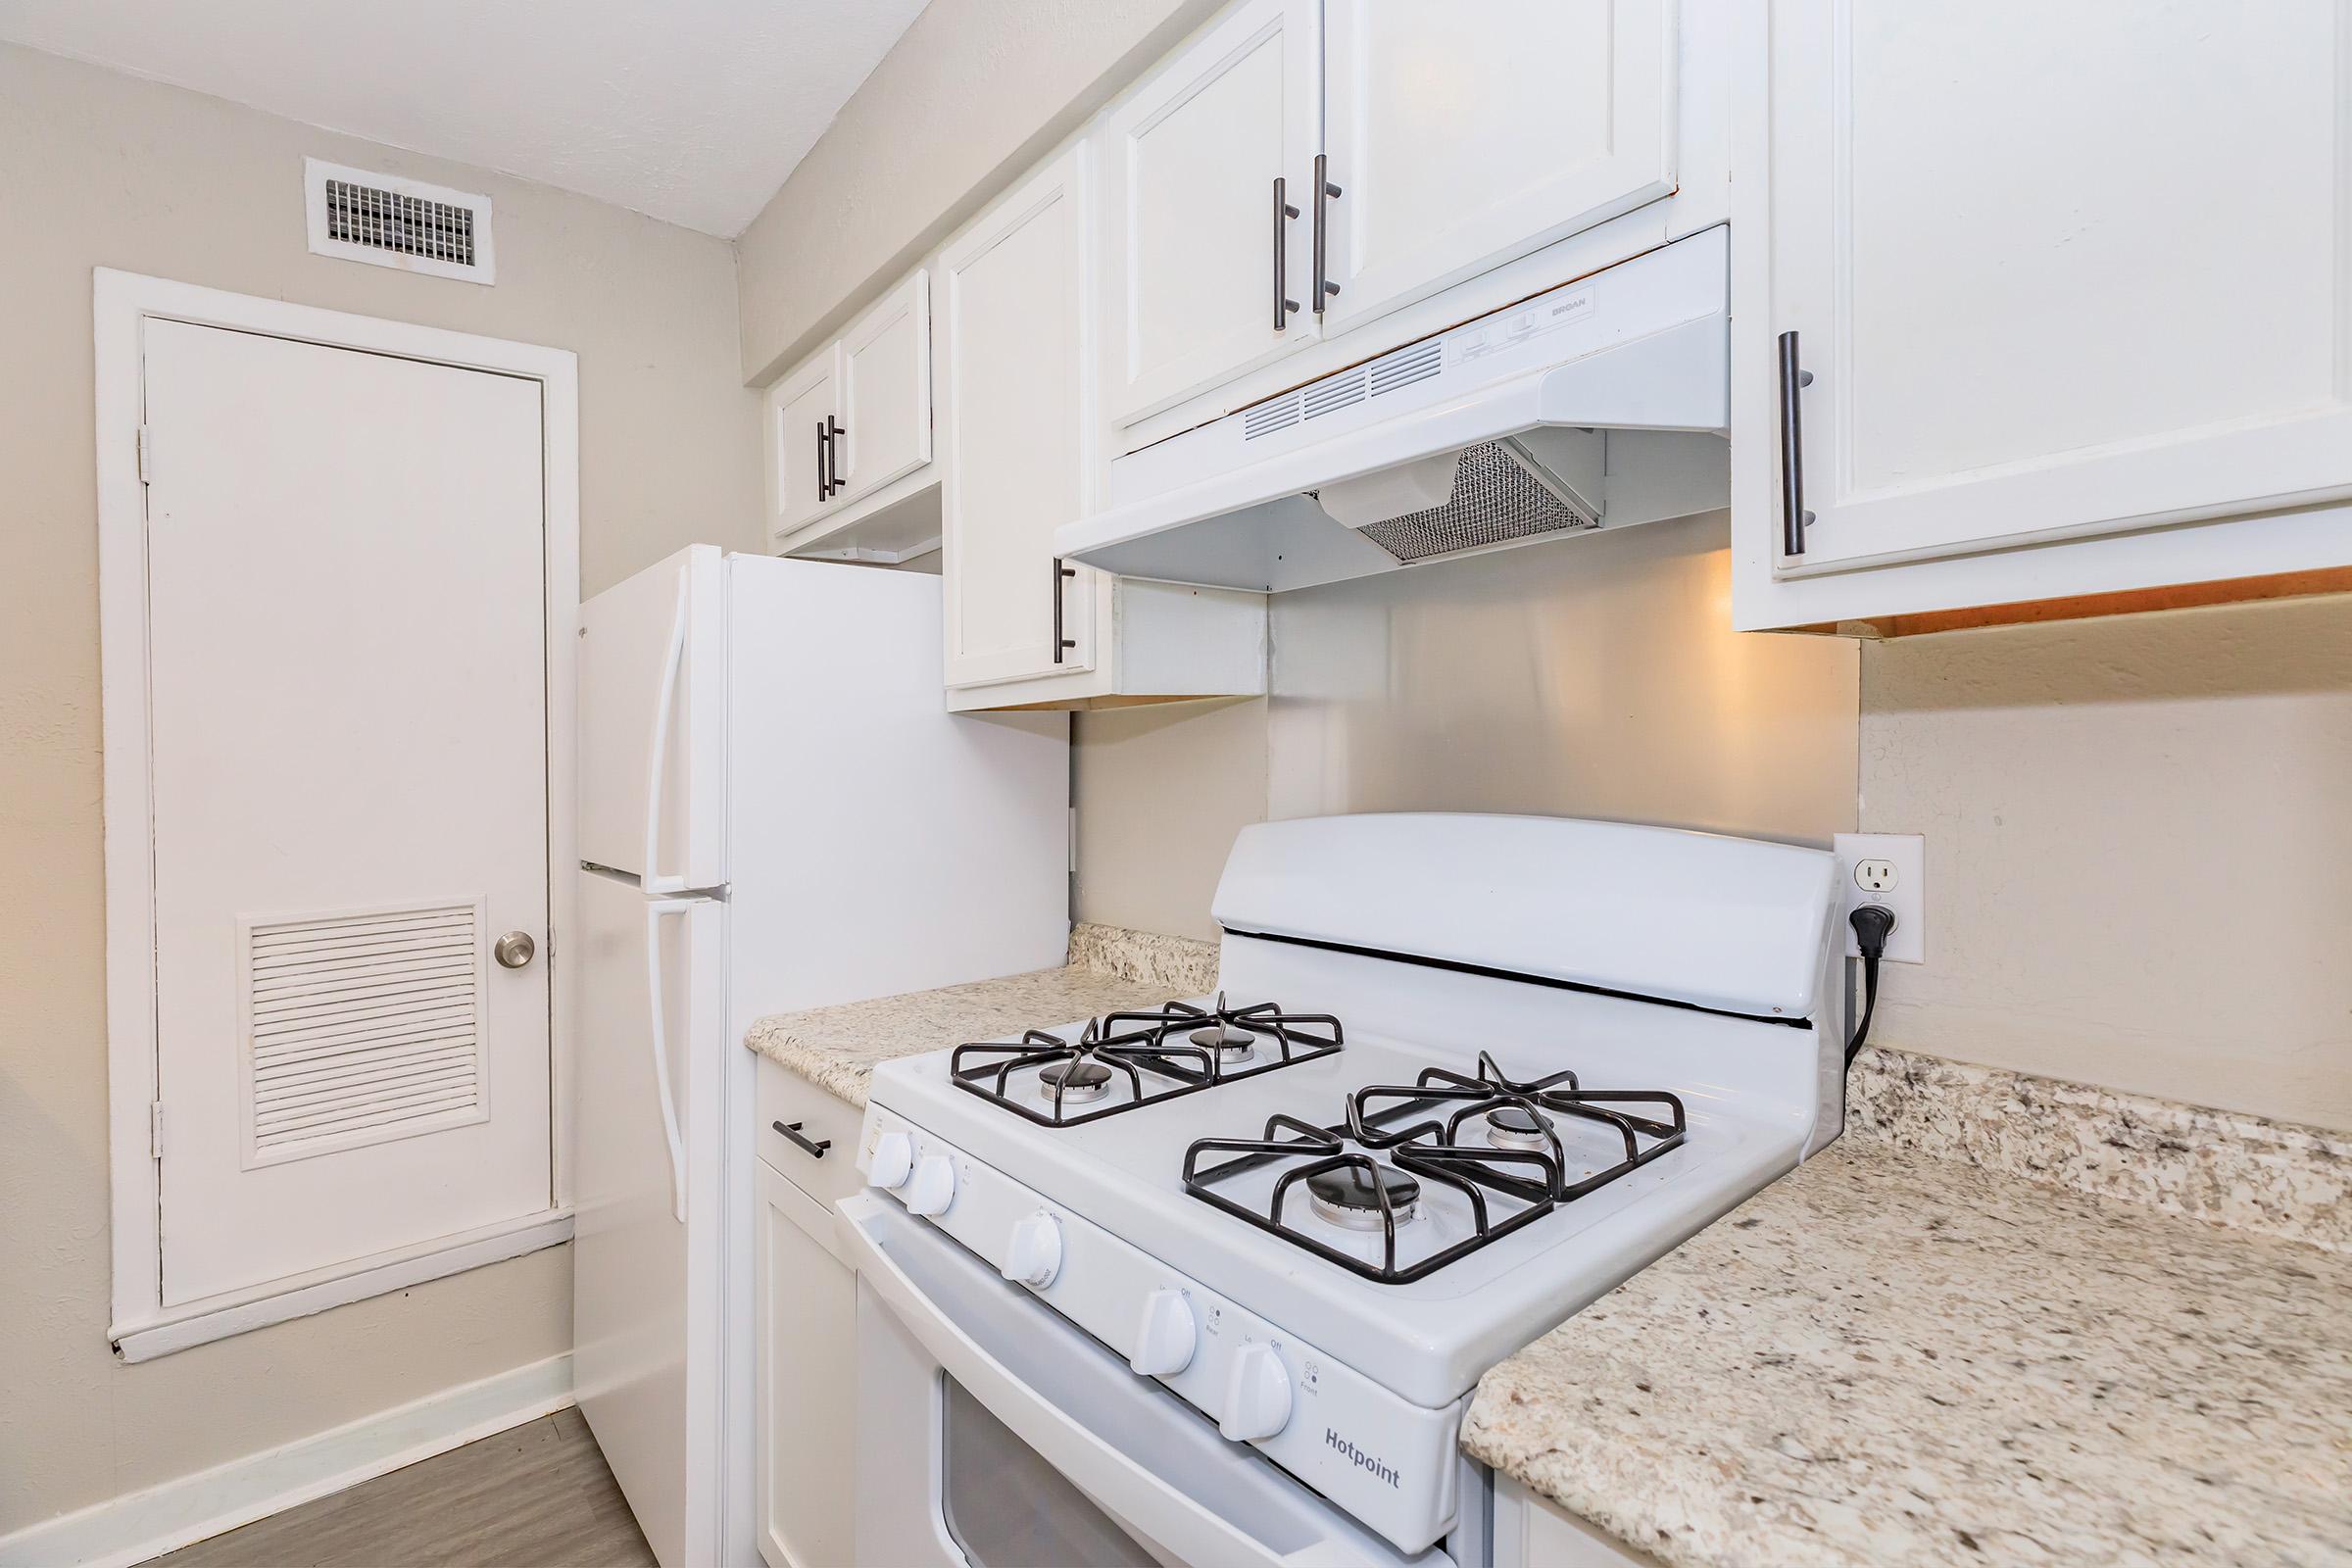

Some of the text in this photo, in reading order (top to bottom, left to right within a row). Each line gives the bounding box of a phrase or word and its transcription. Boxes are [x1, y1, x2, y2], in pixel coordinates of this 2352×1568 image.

[1551, 298, 1586, 317] BROAN
[1270, 1339, 1282, 1350] Off
[1300, 1382, 1318, 1396] Front
[1325, 1428, 1400, 1489] Hotpoint
